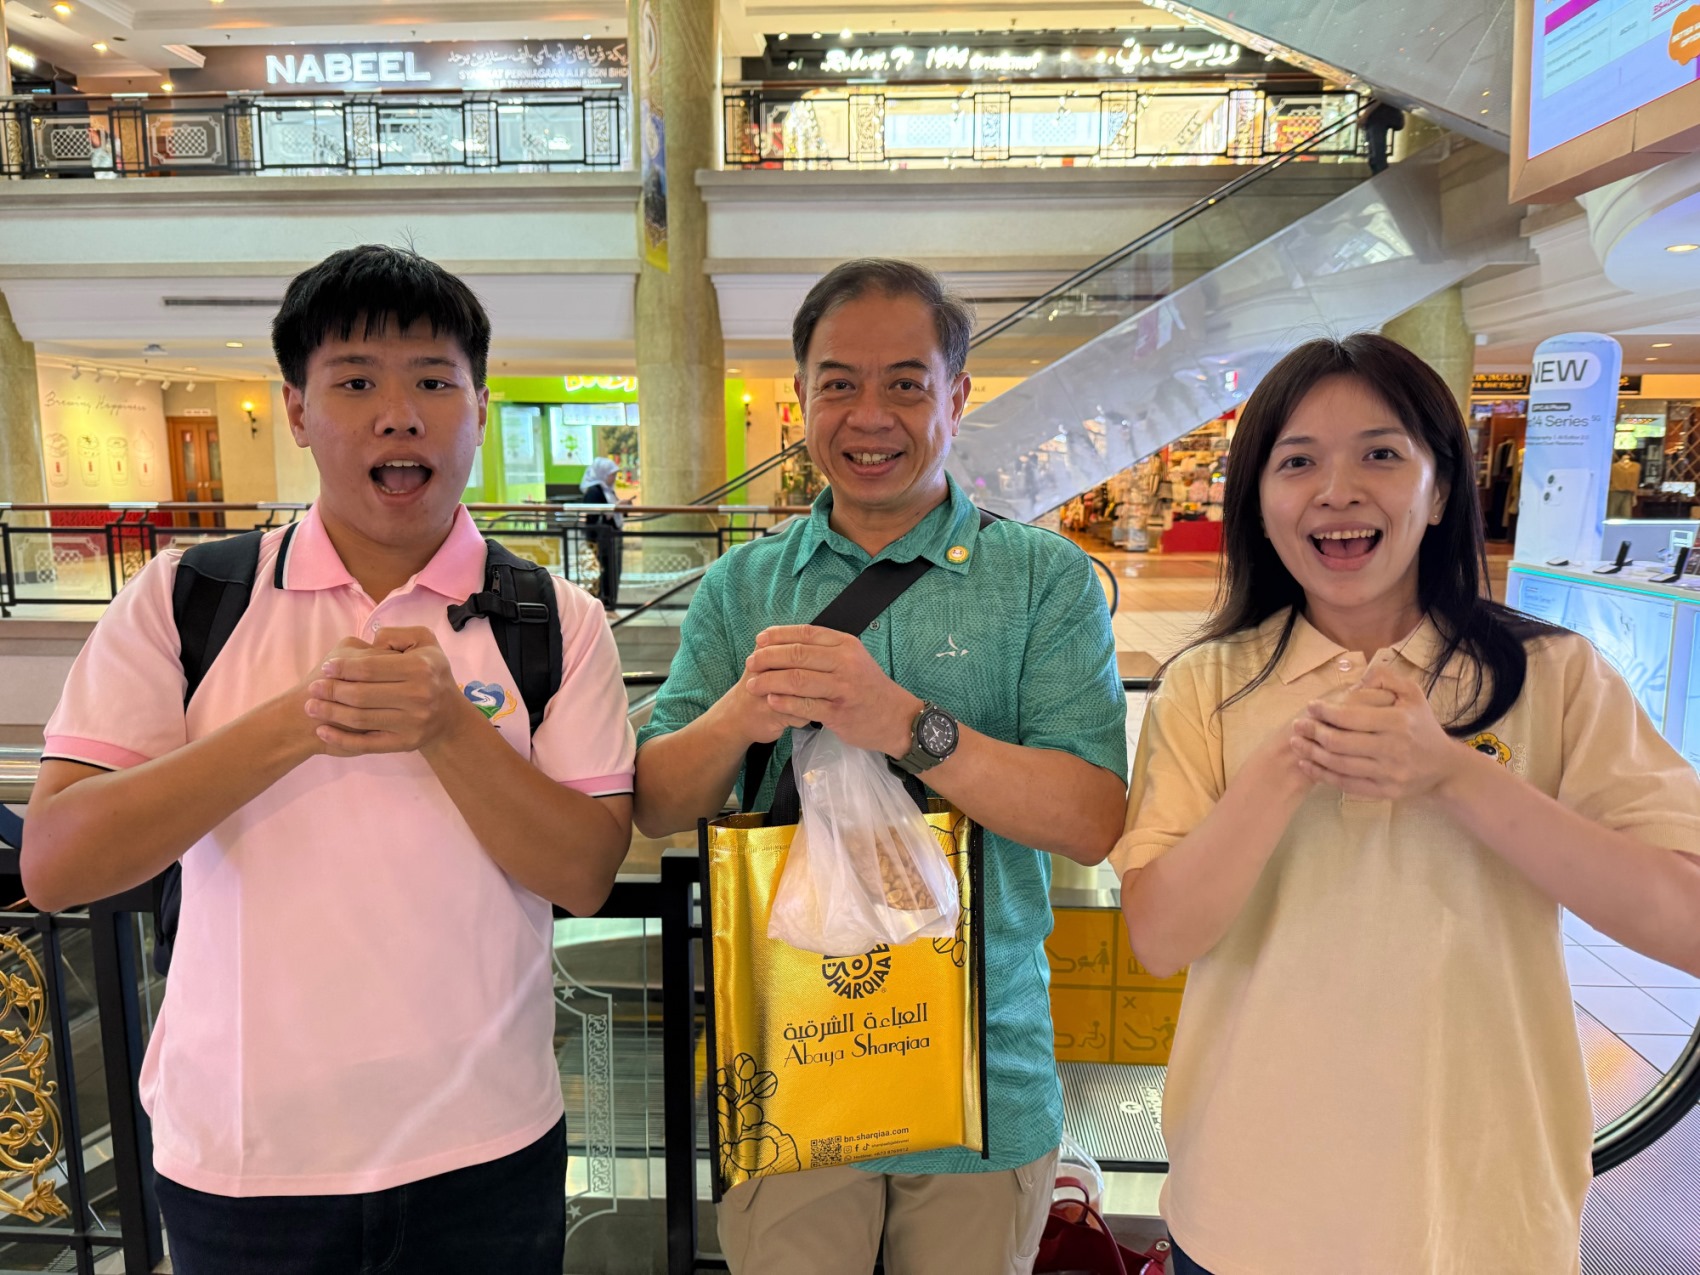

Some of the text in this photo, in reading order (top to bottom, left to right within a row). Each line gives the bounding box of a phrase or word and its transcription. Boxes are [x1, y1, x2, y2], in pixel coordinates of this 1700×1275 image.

[266, 51, 432, 84] NABEEL
[458, 69, 504, 80] SYAKAT
[1533, 359, 1588, 383] NEW
[44, 391, 147, 416] Brewing Happiness
[1545, 414, 1590, 428] Series
[783, 1012, 854, 1043] الشرقية
[783, 1033, 930, 1067] Abaya Sharqiaa
[844, 1127, 910, 1143] bn.sharqiaa.com
